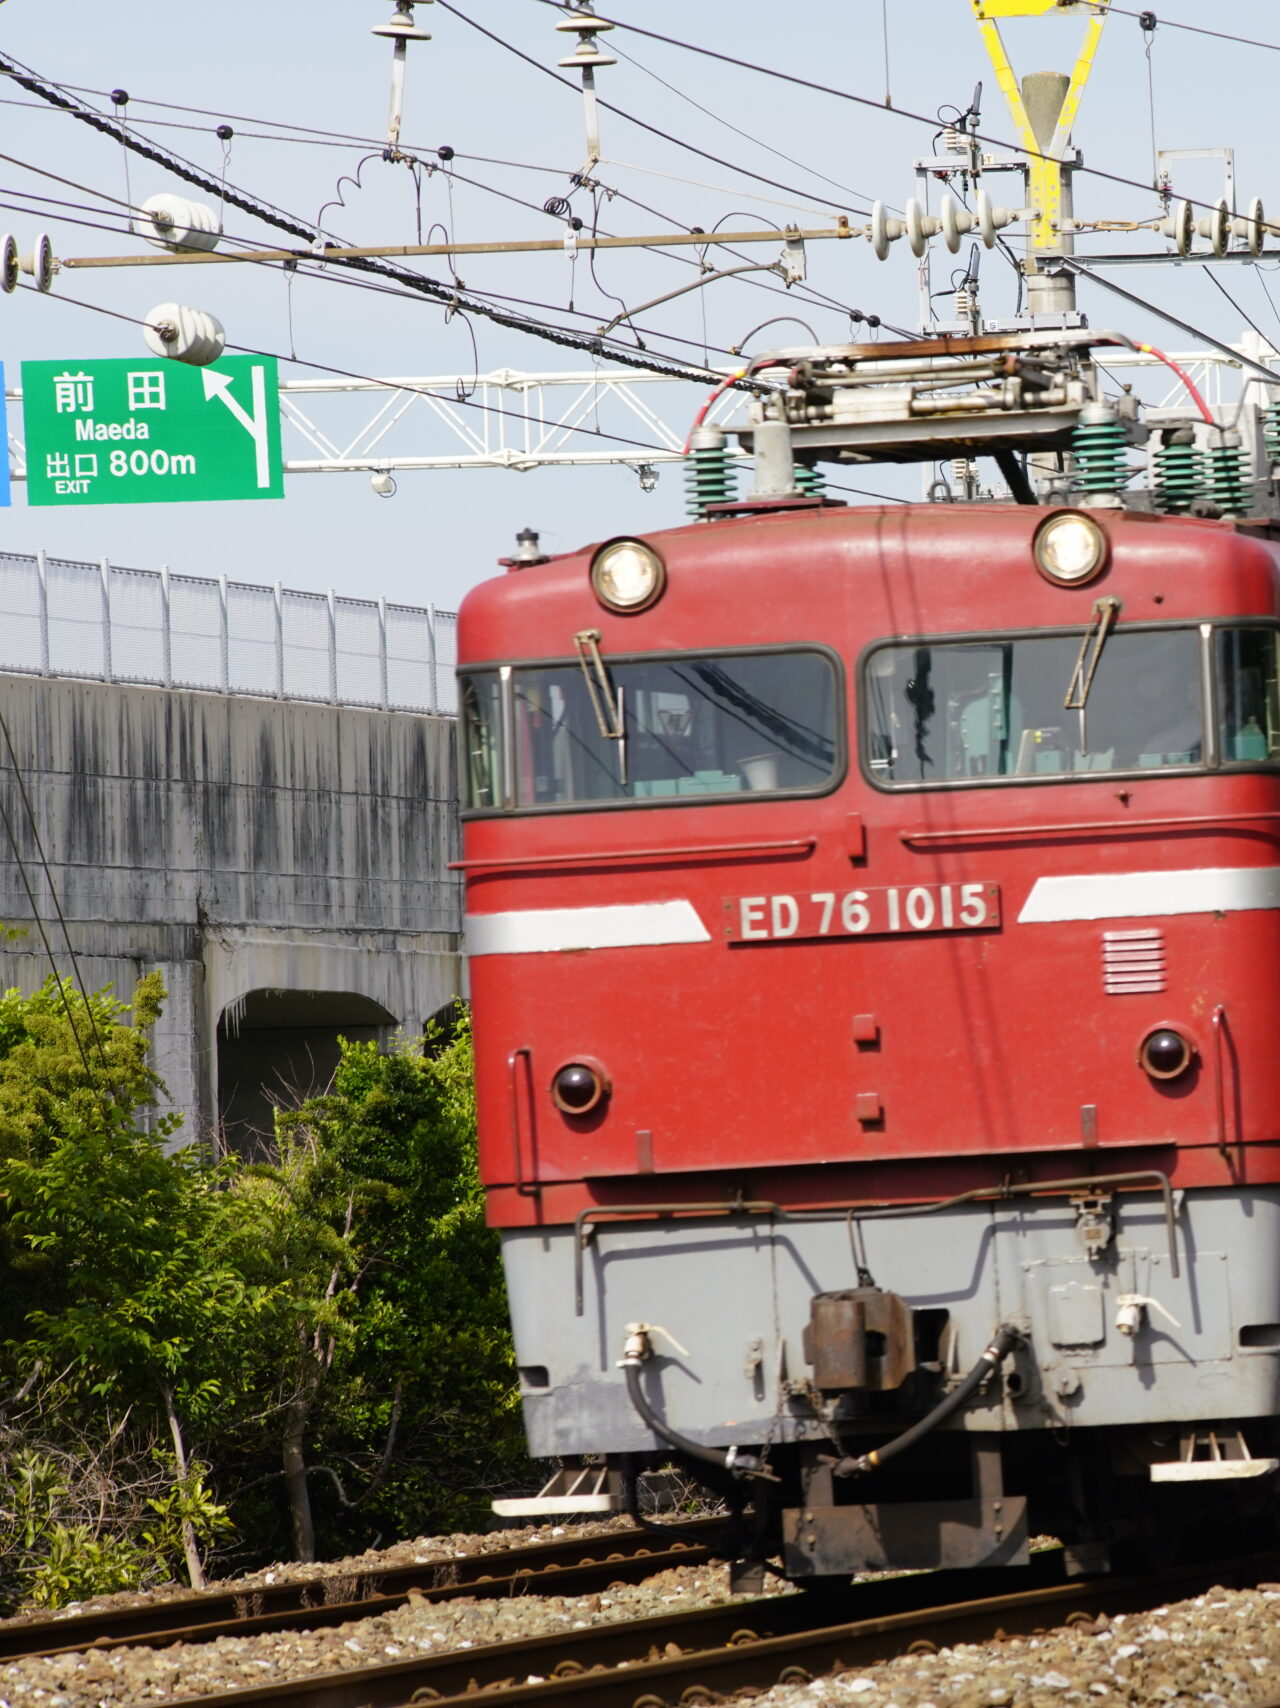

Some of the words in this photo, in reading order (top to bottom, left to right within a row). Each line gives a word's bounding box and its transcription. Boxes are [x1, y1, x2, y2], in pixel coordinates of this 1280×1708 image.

[53, 371, 166, 413] 前田
[75, 418, 149, 441] Maeda
[46, 452, 98, 478] 出口
[109, 449, 196, 477] 800m
[55, 480, 91, 494] EXIT
[740, 895, 799, 939] ED
[811, 891, 870, 934] 76
[888, 884, 986, 930] 1015
